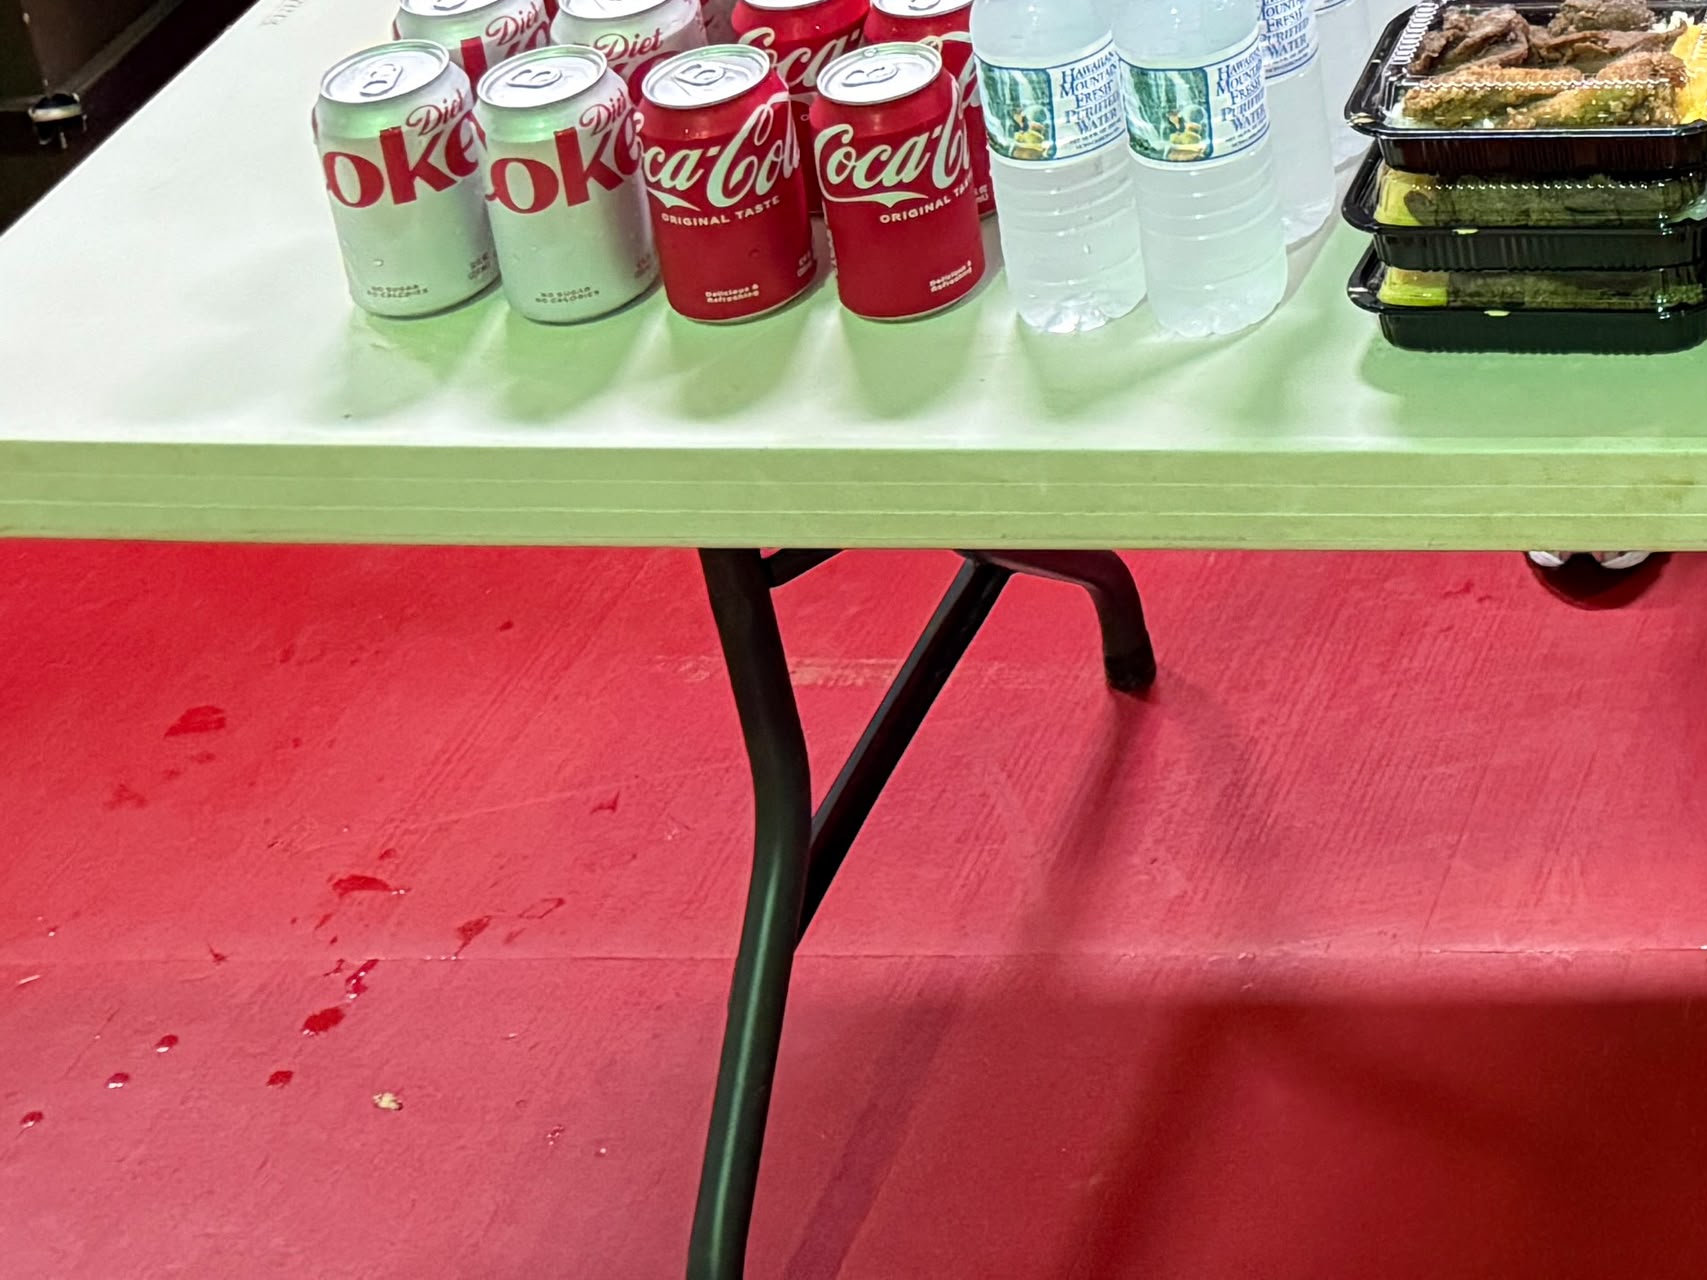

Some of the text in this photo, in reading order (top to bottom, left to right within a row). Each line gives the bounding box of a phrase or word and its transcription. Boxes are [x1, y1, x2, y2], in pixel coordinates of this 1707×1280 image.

[485, 2, 539, 42] Diet
[595, 28, 664, 62] Diet
[405, 89, 466, 137] Diet
[579, 88, 628, 137] Diet
[323, 108, 489, 208] oke
[485, 107, 642, 214] oke
[661, 195, 781, 227] ORIGINAL TASTE
[879, 195, 951, 224] ORIGINAL
